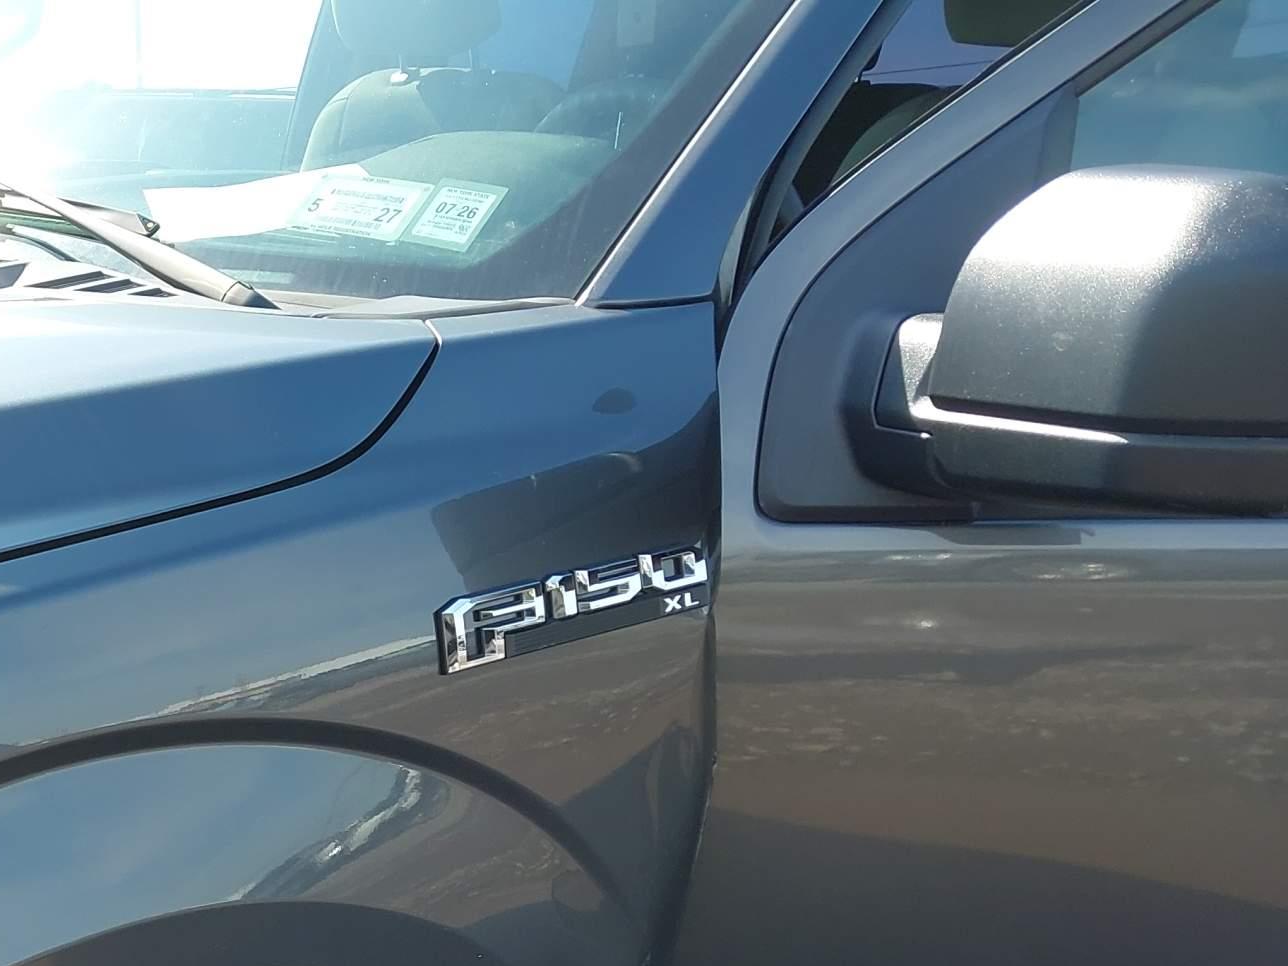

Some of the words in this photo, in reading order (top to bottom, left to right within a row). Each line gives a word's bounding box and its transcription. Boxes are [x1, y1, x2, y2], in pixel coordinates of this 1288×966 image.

[307, 198, 324, 212] 5
[435, 202, 457, 214] 07
[457, 205, 479, 219] 26
[373, 207, 402, 223] 27
[663, 593, 700, 613] XL
[434, 551, 709, 674] F150
